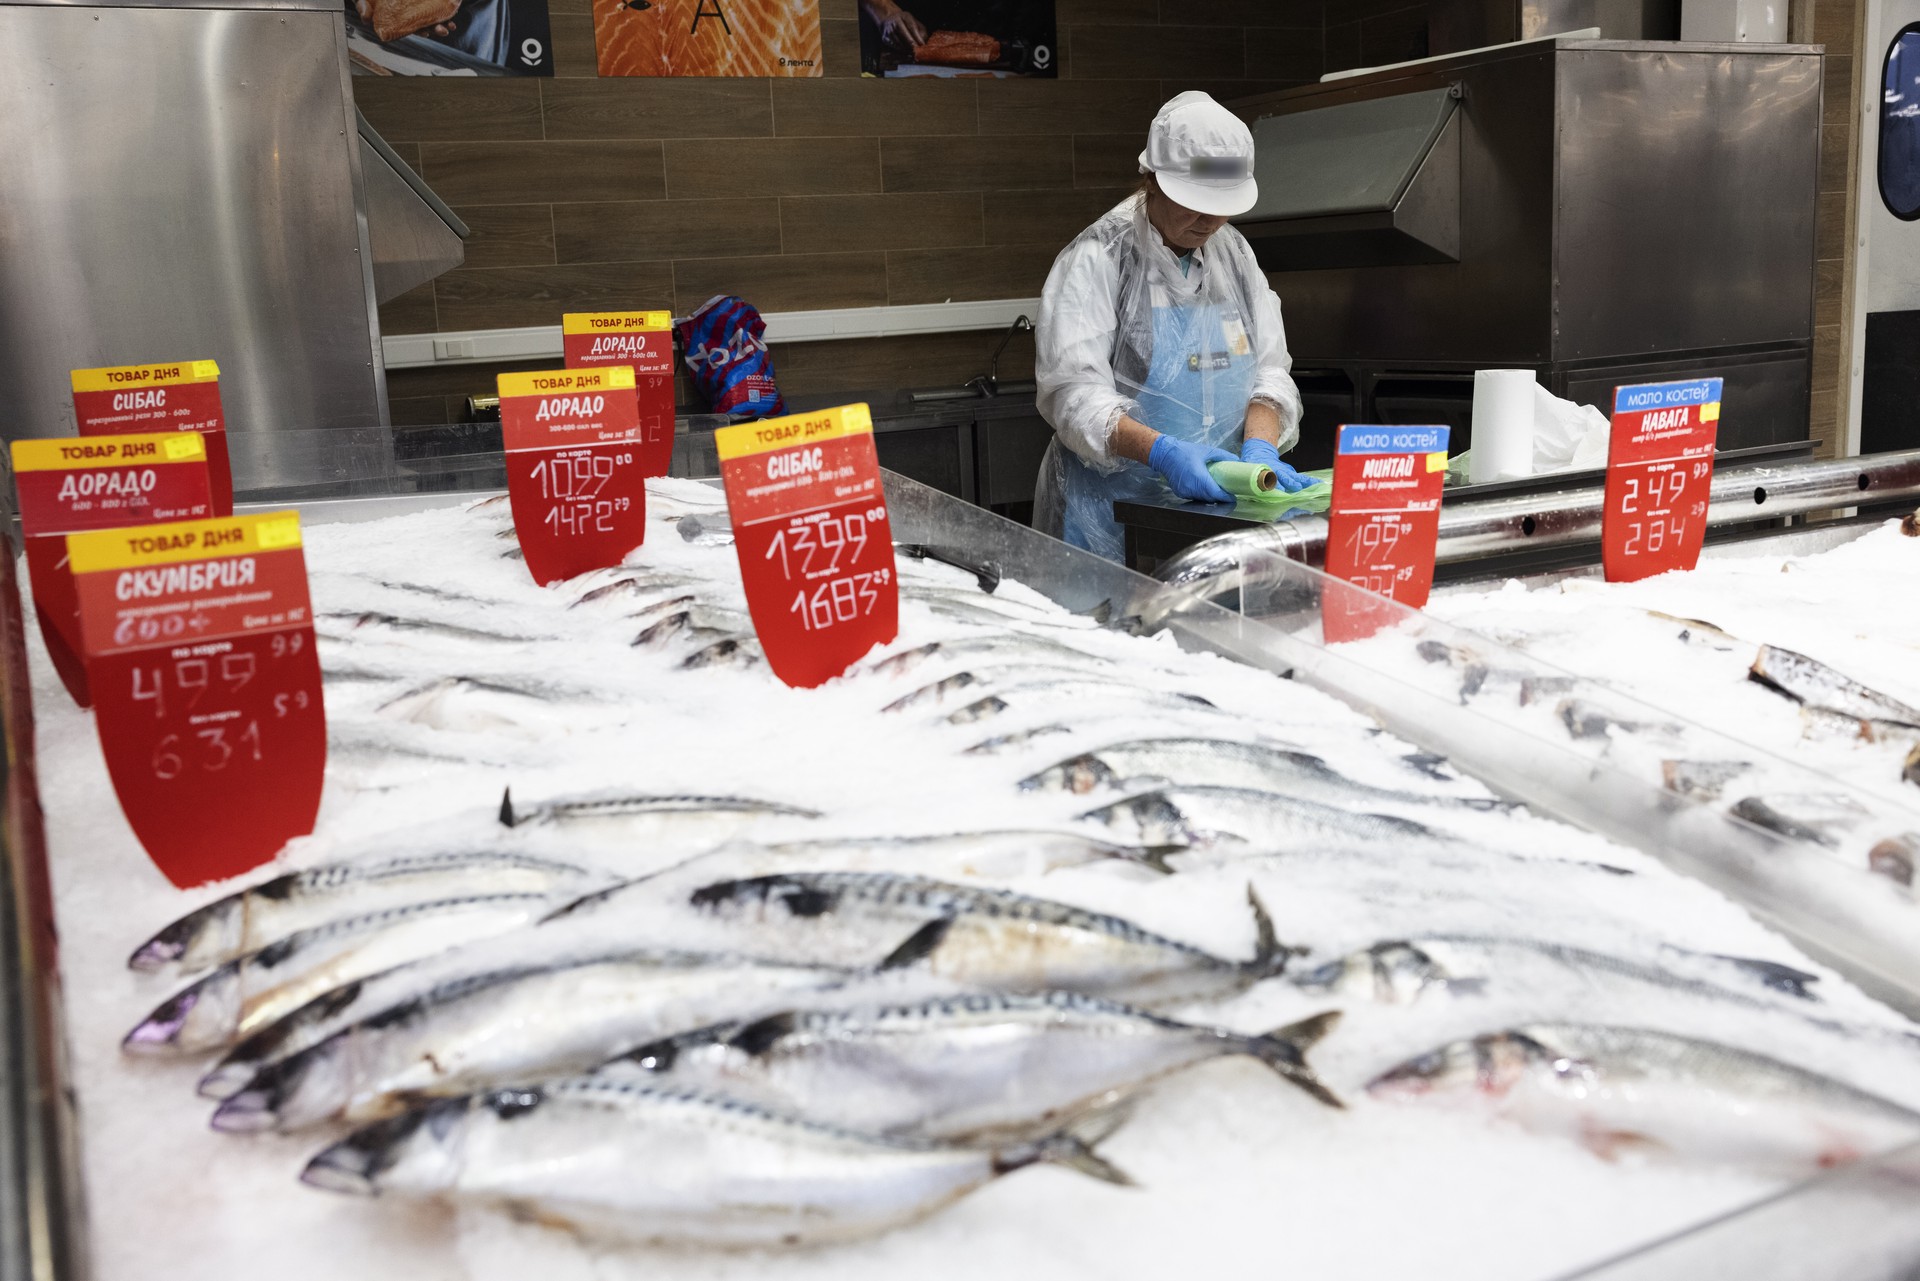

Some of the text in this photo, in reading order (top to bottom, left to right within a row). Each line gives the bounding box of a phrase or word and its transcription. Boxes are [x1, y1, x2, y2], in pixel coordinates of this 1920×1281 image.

[787, 58, 814, 67] лента
[590, 319, 622, 327] ТОВАР
[624, 318, 644, 327] ДНЯ
[591, 336, 646, 355] ДОРАДО
[106, 370, 150, 383] ТОВАР
[153, 367, 180, 381] ДНЯ
[533, 377, 573, 389] ТОВАР
[576, 375, 601, 388] ДНЯ
[113, 389, 167, 411] СИБАС
[1627, 383, 1709, 406] мало костей
[535, 395, 605, 421] ДОРАДО
[1641, 407, 1688, 432] НАВАГА
[178, 422, 195, 431] Цена
[598, 431, 614, 440] Цена
[755, 425, 800, 444] ТОВАР
[804, 418, 832, 435] ДНЯ
[1352, 430, 1438, 448] мало костей
[60, 445, 117, 460] ТОВАР
[121, 442, 156, 458] ДНЯ
[568, 449, 592, 458] карте
[767, 447, 823, 480] СИБАС
[1362, 454, 1415, 478] МИНТАЙ
[1656, 463, 1675, 472] карте
[58, 469, 157, 501] ДОРАДО
[530, 453, 633, 499] 1099 00
[1622, 462, 1708, 513] 249 99
[153, 508, 175, 519] Цена
[790, 511, 831, 526] по карте
[127, 533, 196, 555] ТОВАР
[202, 528, 244, 548] ДНЯ
[765, 506, 885, 581] 1399 00
[1345, 523, 1400, 567] 199
[1624, 517, 1686, 555] 284
[115, 558, 256, 601] СКУМБРИЯ
[790, 572, 878, 631] 1683
[171, 642, 233, 659] по карте
[132, 653, 256, 719] 499
[152, 720, 262, 780] 631
